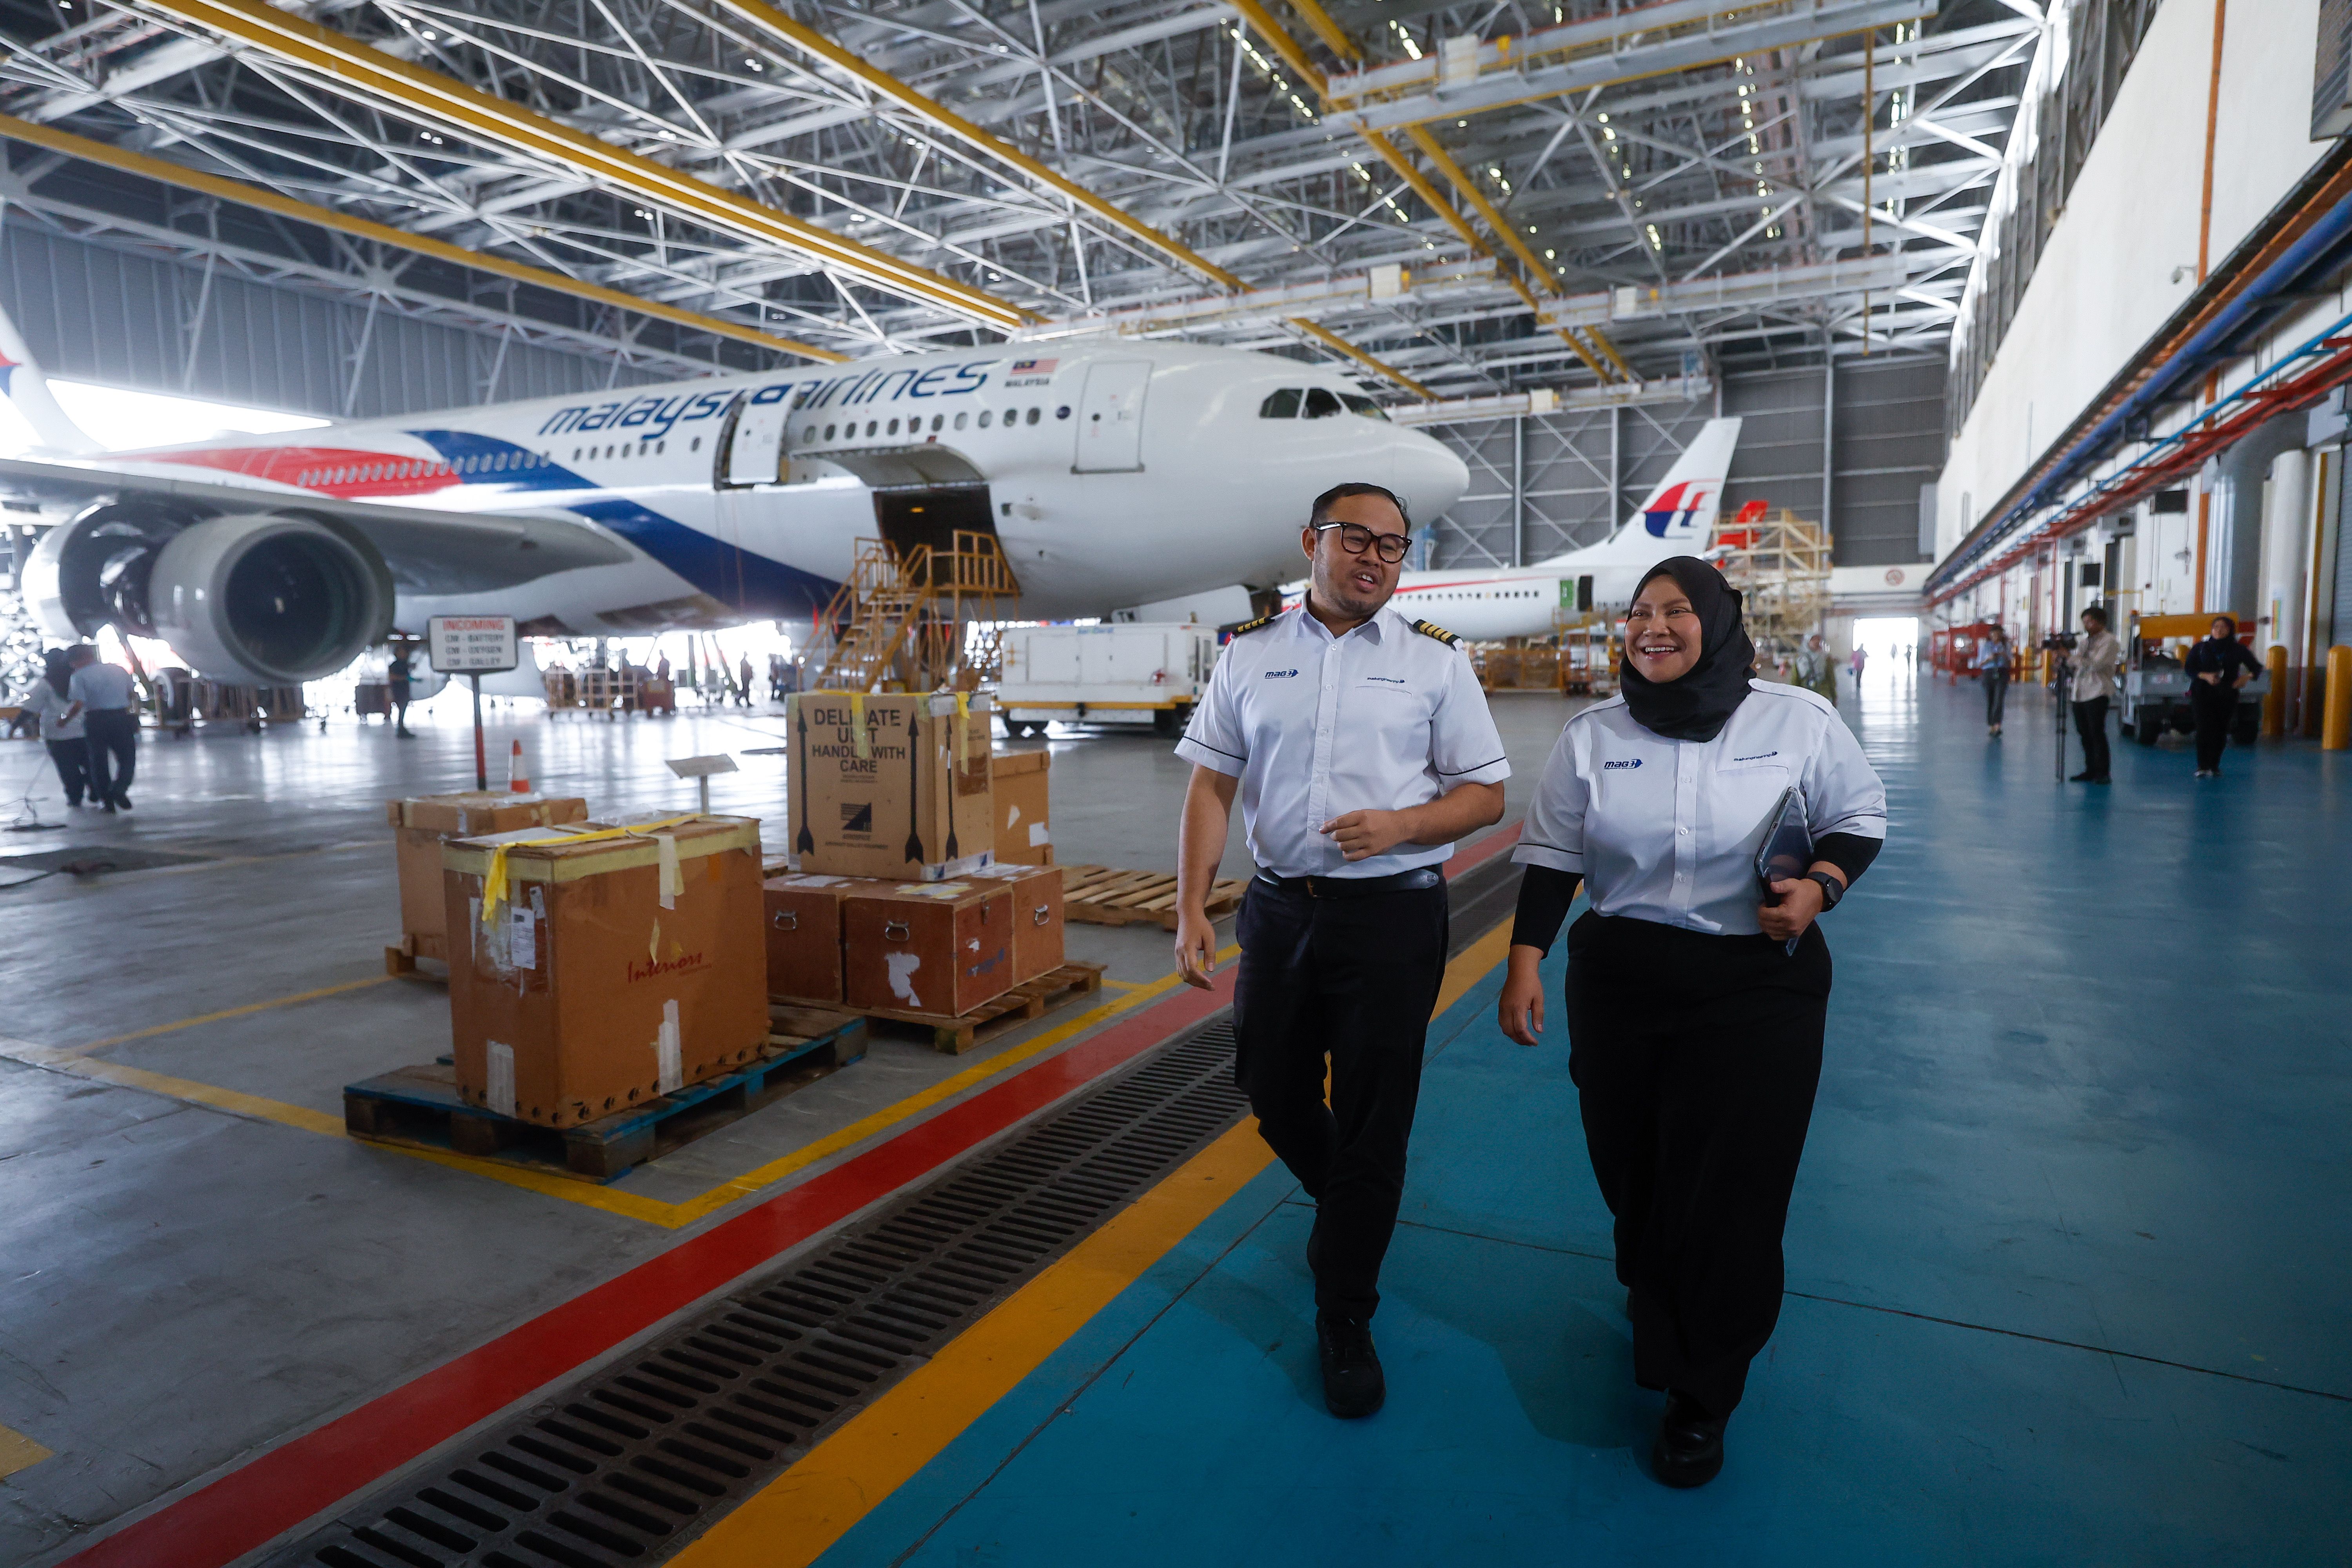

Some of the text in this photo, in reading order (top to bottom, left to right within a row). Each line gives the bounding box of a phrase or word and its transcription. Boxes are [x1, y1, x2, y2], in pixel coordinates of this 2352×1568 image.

[443, 618, 505, 631] INCOMING
[814, 708, 901, 726] DELIATE
[837, 727, 878, 743] UT
[812, 745, 905, 759] HANDL WITH
[840, 760, 878, 773] CARE
